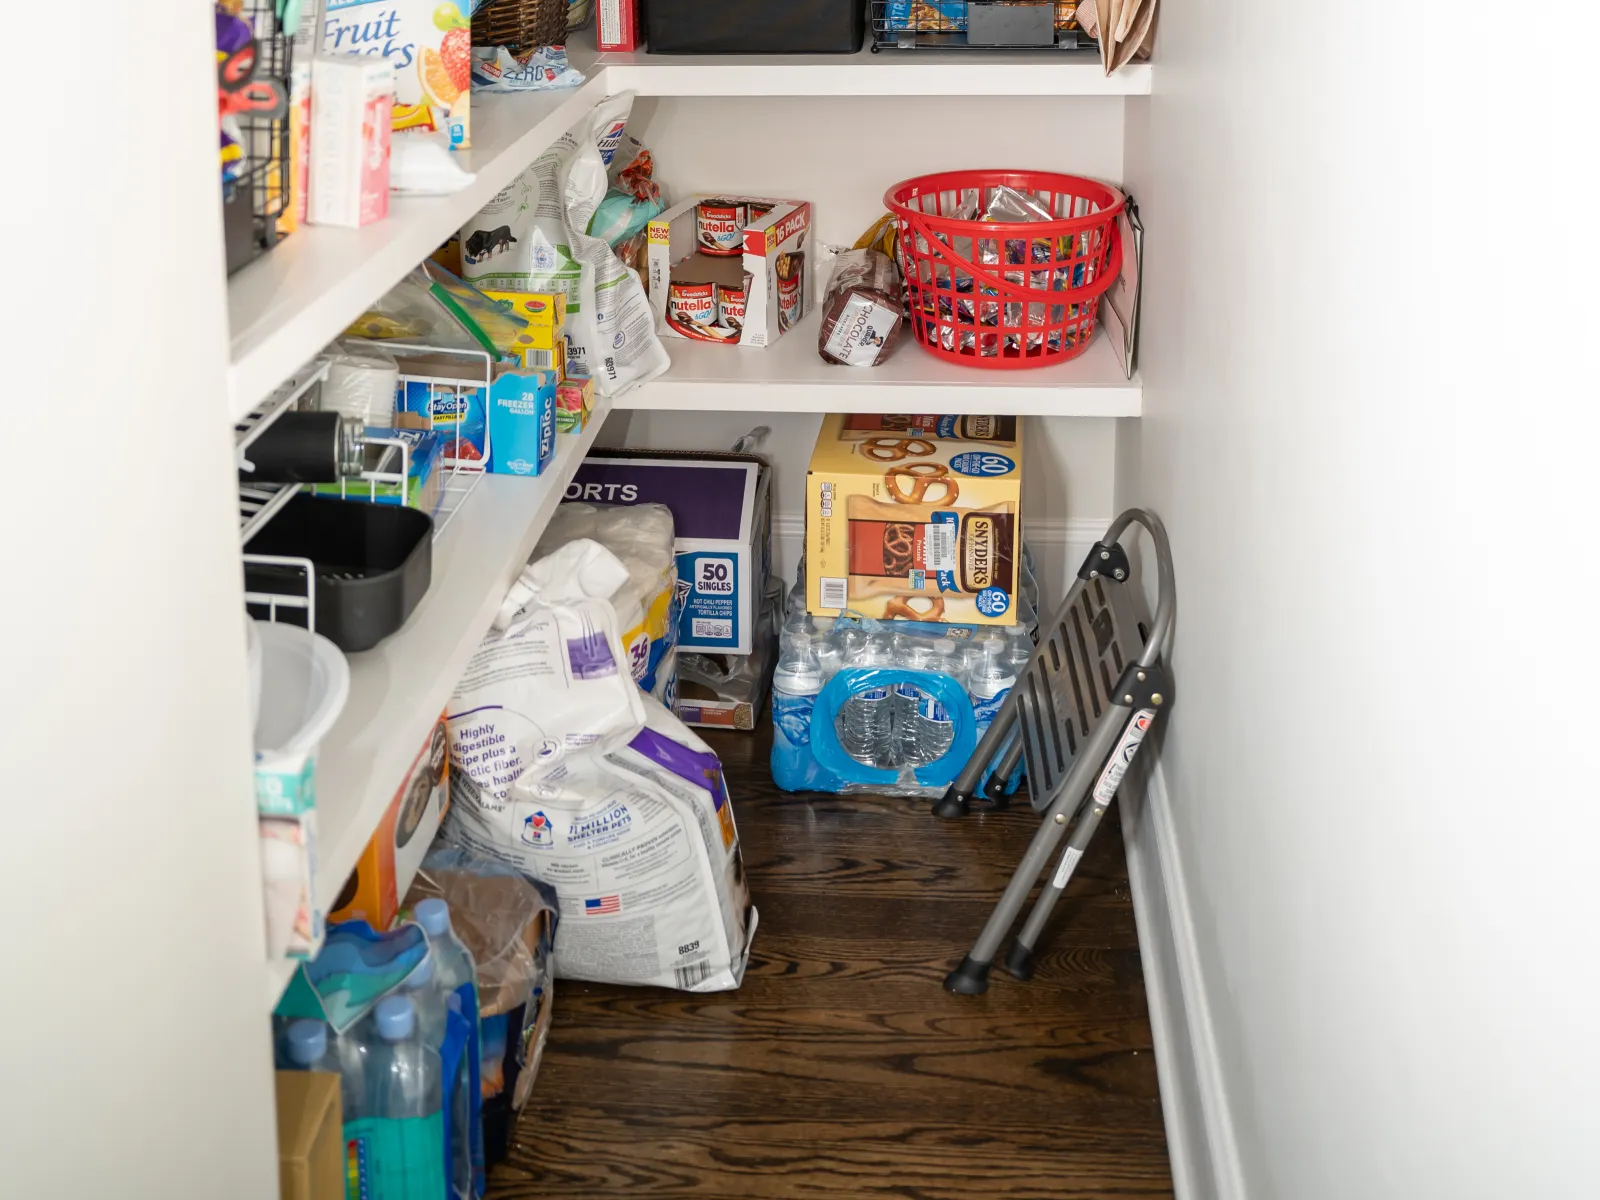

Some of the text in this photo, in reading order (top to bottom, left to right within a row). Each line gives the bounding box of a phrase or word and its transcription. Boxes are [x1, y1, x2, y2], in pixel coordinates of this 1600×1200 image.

[325, 10, 401, 48] Fruit
[503, 65, 544, 81] ZERO
[698, 220, 734, 233] nutella
[776, 211, 806, 243] 16 PACK
[716, 232, 736, 241] &GO!
[670, 300, 712, 311] nutella
[779, 291, 798, 310] utella
[695, 309, 712, 320] &GO!
[721, 305, 744, 316] nute
[839, 305, 873, 359] CHOCOLATE
[860, 325, 873, 346] QUAKER
[568, 347, 586, 355] 3971
[498, 399, 534, 409] FREEZER
[522, 392, 533, 400] 28
[981, 456, 1009, 474] 60
[563, 483, 638, 501] ORTS
[973, 521, 988, 584] SNYDER'S
[702, 564, 727, 581] 50
[940, 570, 950, 586] ack
[698, 582, 732, 591] SINGLES
[992, 591, 1006, 612] 60
[631, 637, 648, 667] 36
[460, 724, 495, 739] Highly
[453, 734, 505, 754] digestible
[482, 748, 505, 762] plus
[494, 757, 522, 771] fiber.
[581, 804, 628, 832] MILLION
[567, 814, 632, 842] SHELTER PETS
[602, 836, 658, 863] CLINICALLY PROVEN
[678, 940, 699, 955] 8839
